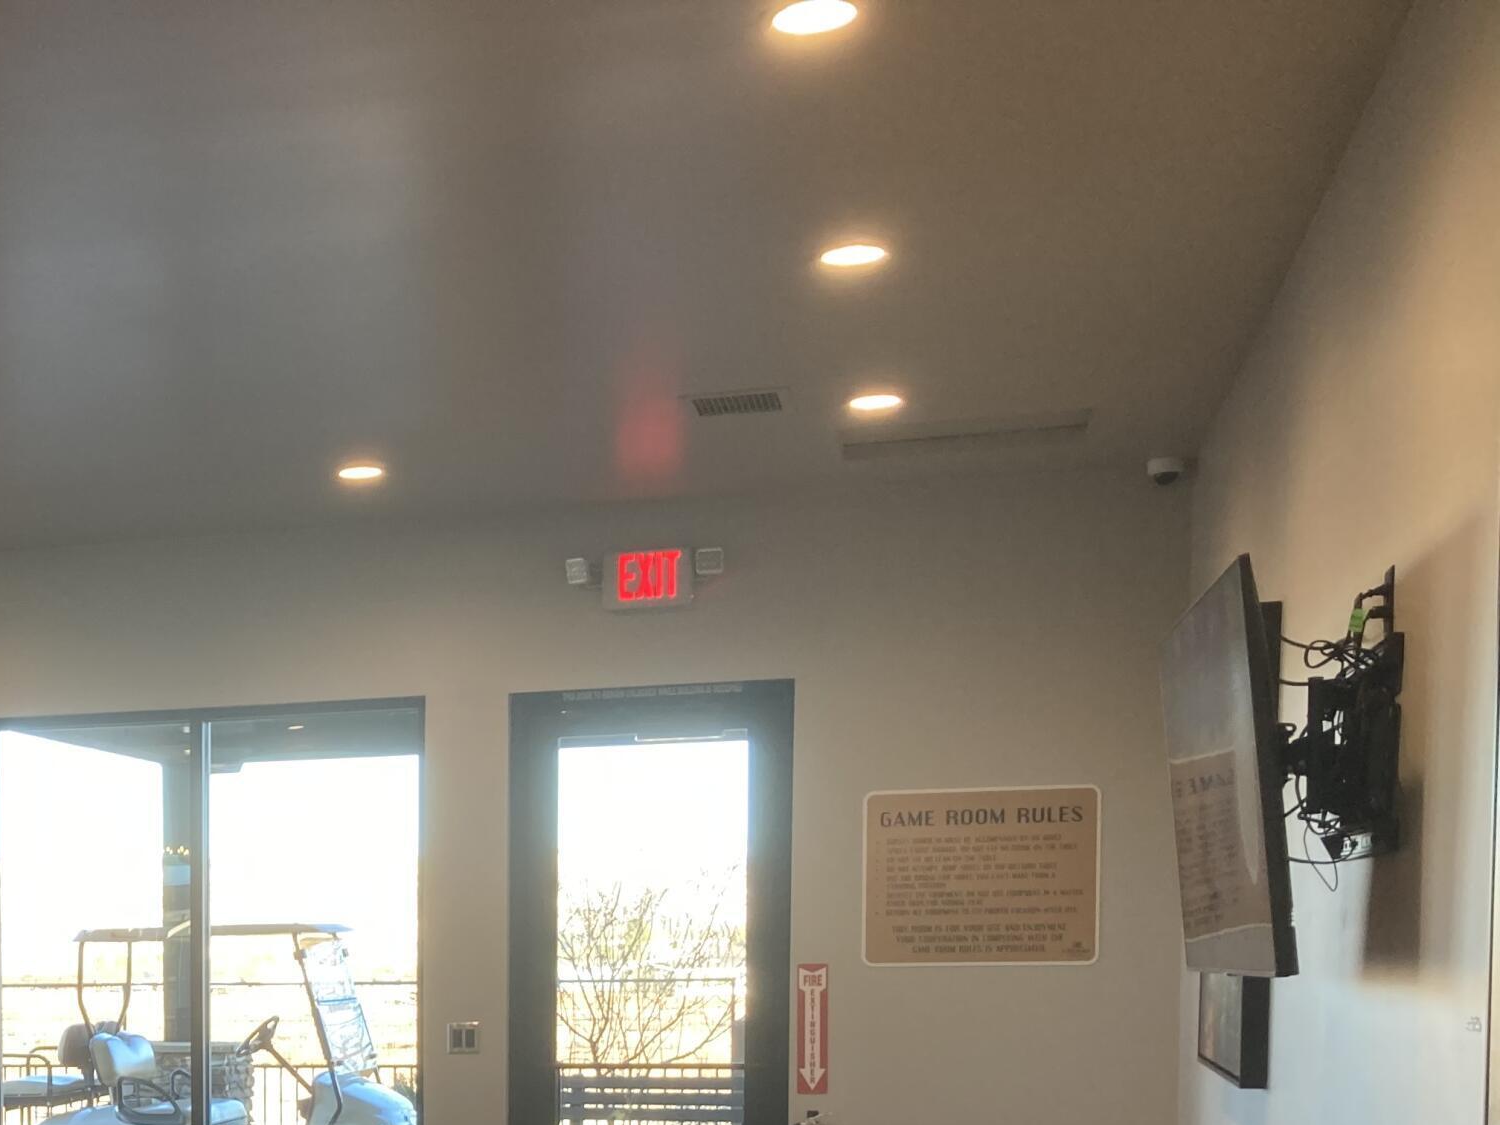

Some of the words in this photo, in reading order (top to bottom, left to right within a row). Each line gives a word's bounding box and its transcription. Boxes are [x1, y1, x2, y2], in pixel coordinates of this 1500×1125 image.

[617, 549, 682, 602] EXIT
[880, 810, 934, 828] GAME
[945, 808, 1006, 825] ROOM
[1016, 806, 1084, 824] RULES
[803, 974, 822, 986] FIRE
[808, 988, 816, 1084] EXTINGUISHER
